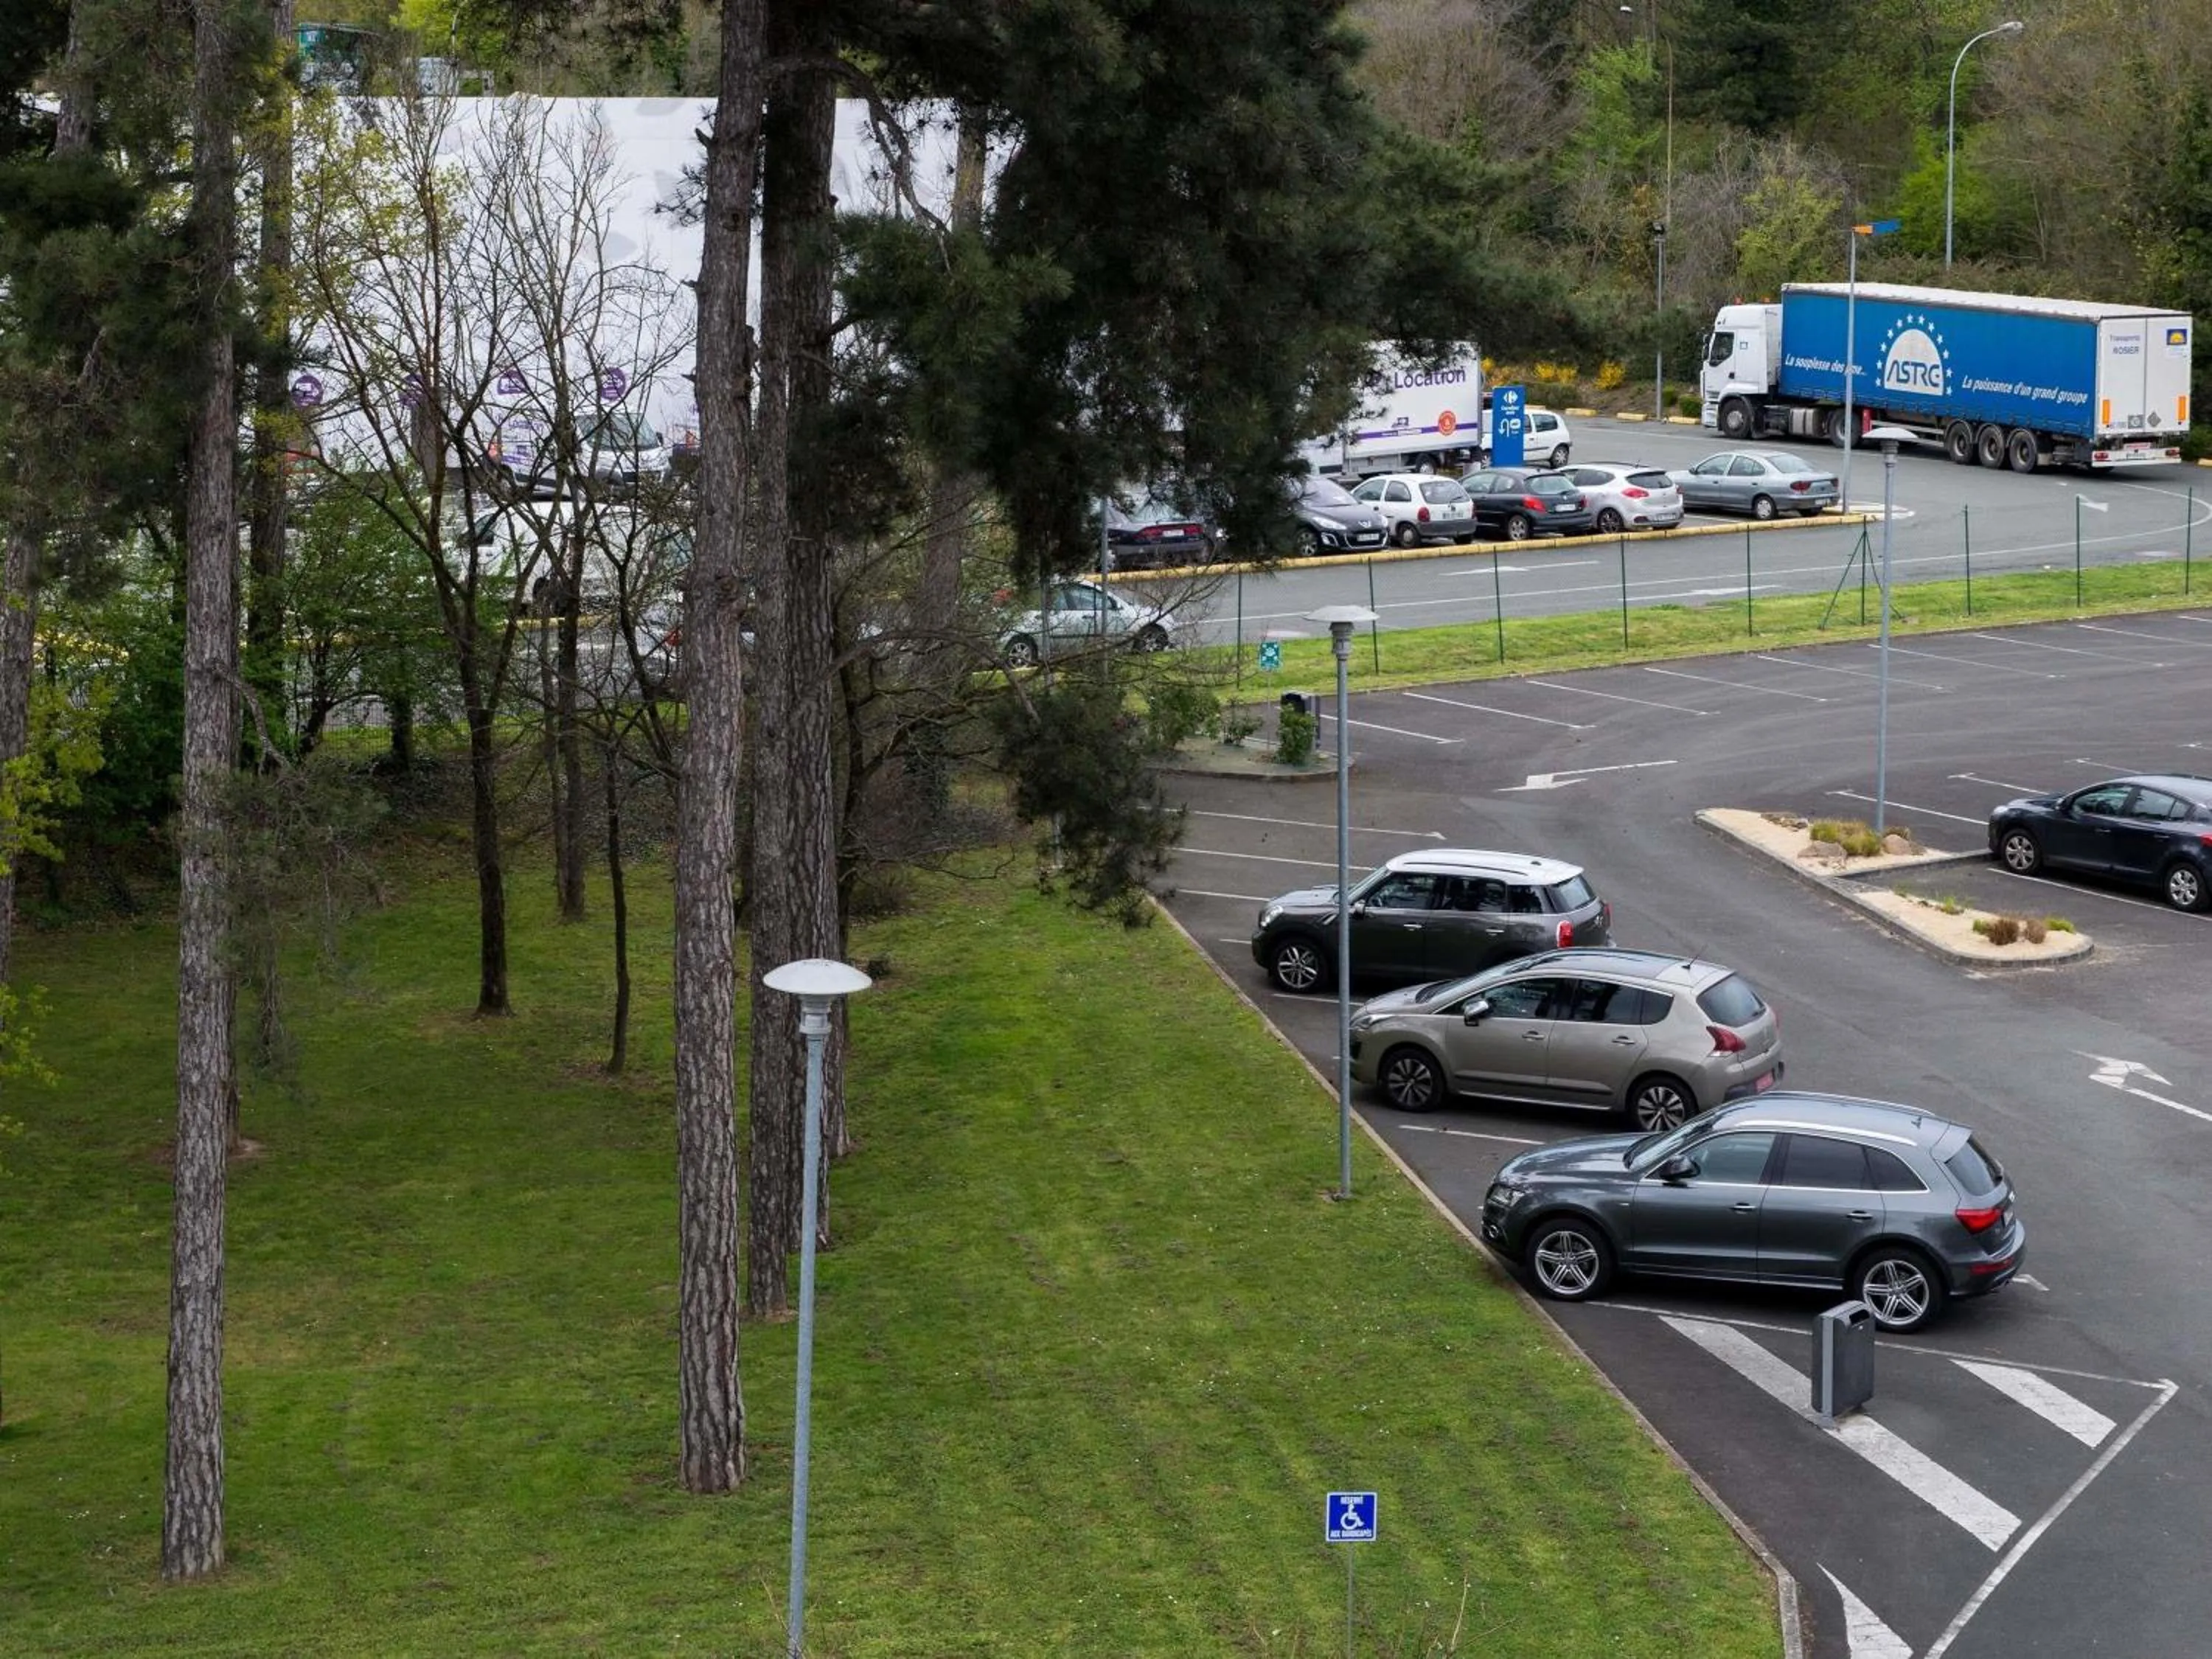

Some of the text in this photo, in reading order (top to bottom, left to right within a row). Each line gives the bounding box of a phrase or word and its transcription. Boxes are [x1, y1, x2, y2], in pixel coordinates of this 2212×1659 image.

[1785, 353, 1795, 366] La
[1831, 359, 1845, 373] des
[1886, 358, 1940, 388] ASTRE
[1394, 367, 1466, 389] Location
[1962, 375, 2089, 406] La puissance d'un grand groupe
